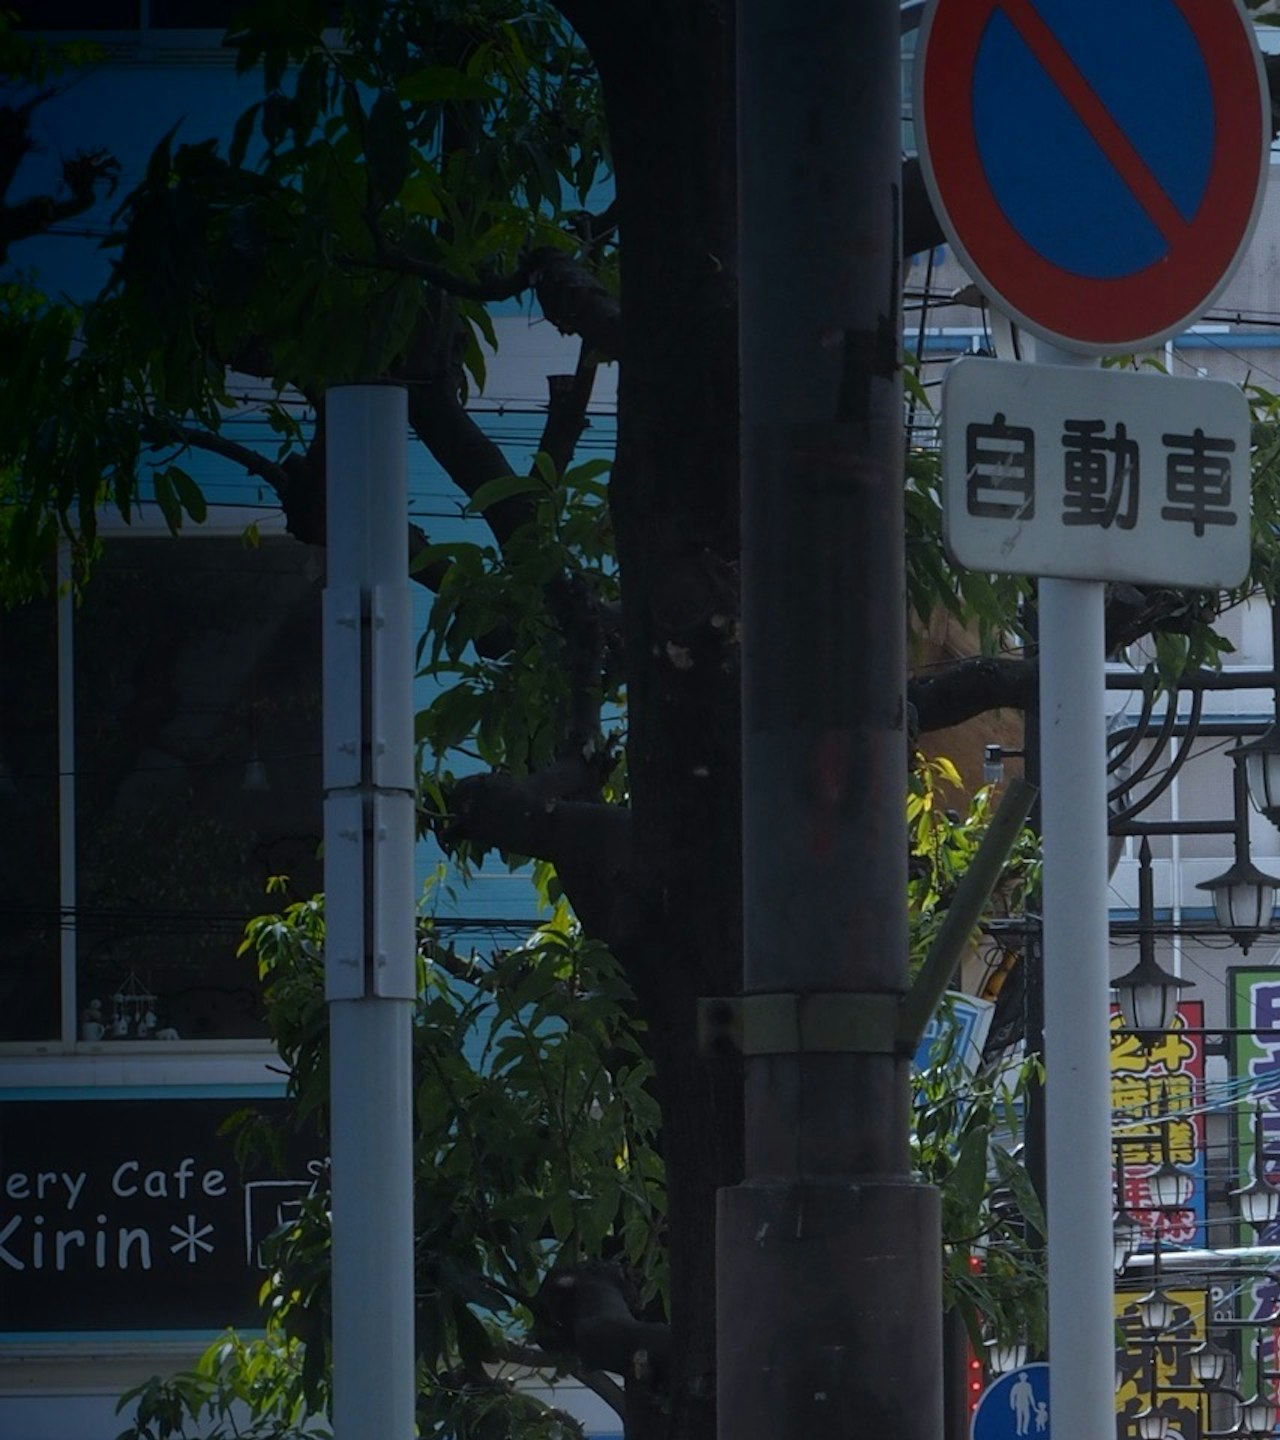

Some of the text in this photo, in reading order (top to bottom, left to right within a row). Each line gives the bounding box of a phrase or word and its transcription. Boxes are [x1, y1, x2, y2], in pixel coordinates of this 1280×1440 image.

[966, 412, 1238, 538] 自動車
[112, 1158, 227, 1199] Cafe
